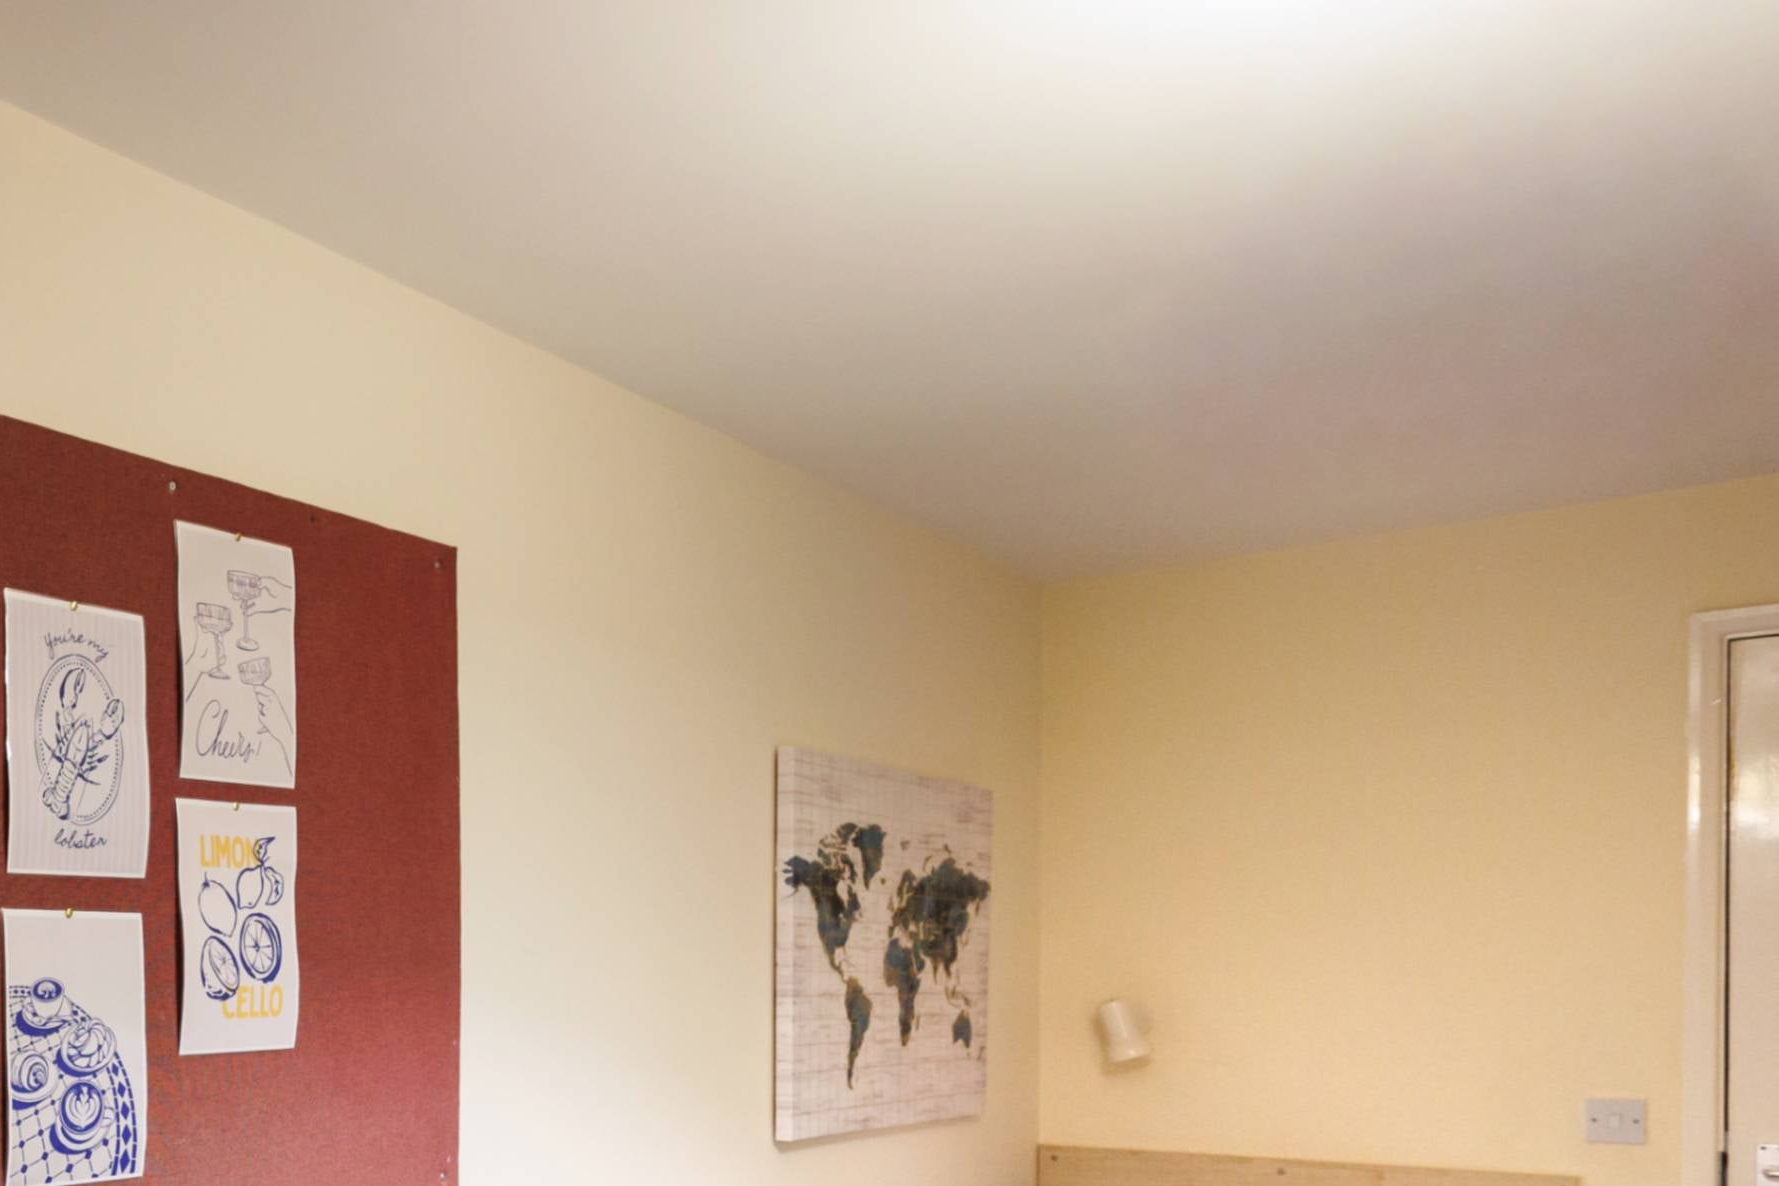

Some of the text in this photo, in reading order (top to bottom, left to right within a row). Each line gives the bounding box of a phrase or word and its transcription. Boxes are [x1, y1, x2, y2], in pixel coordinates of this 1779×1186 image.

[87, 640, 109, 663] my
[54, 828, 107, 849] lobster
[199, 833, 260, 869] LIMON
